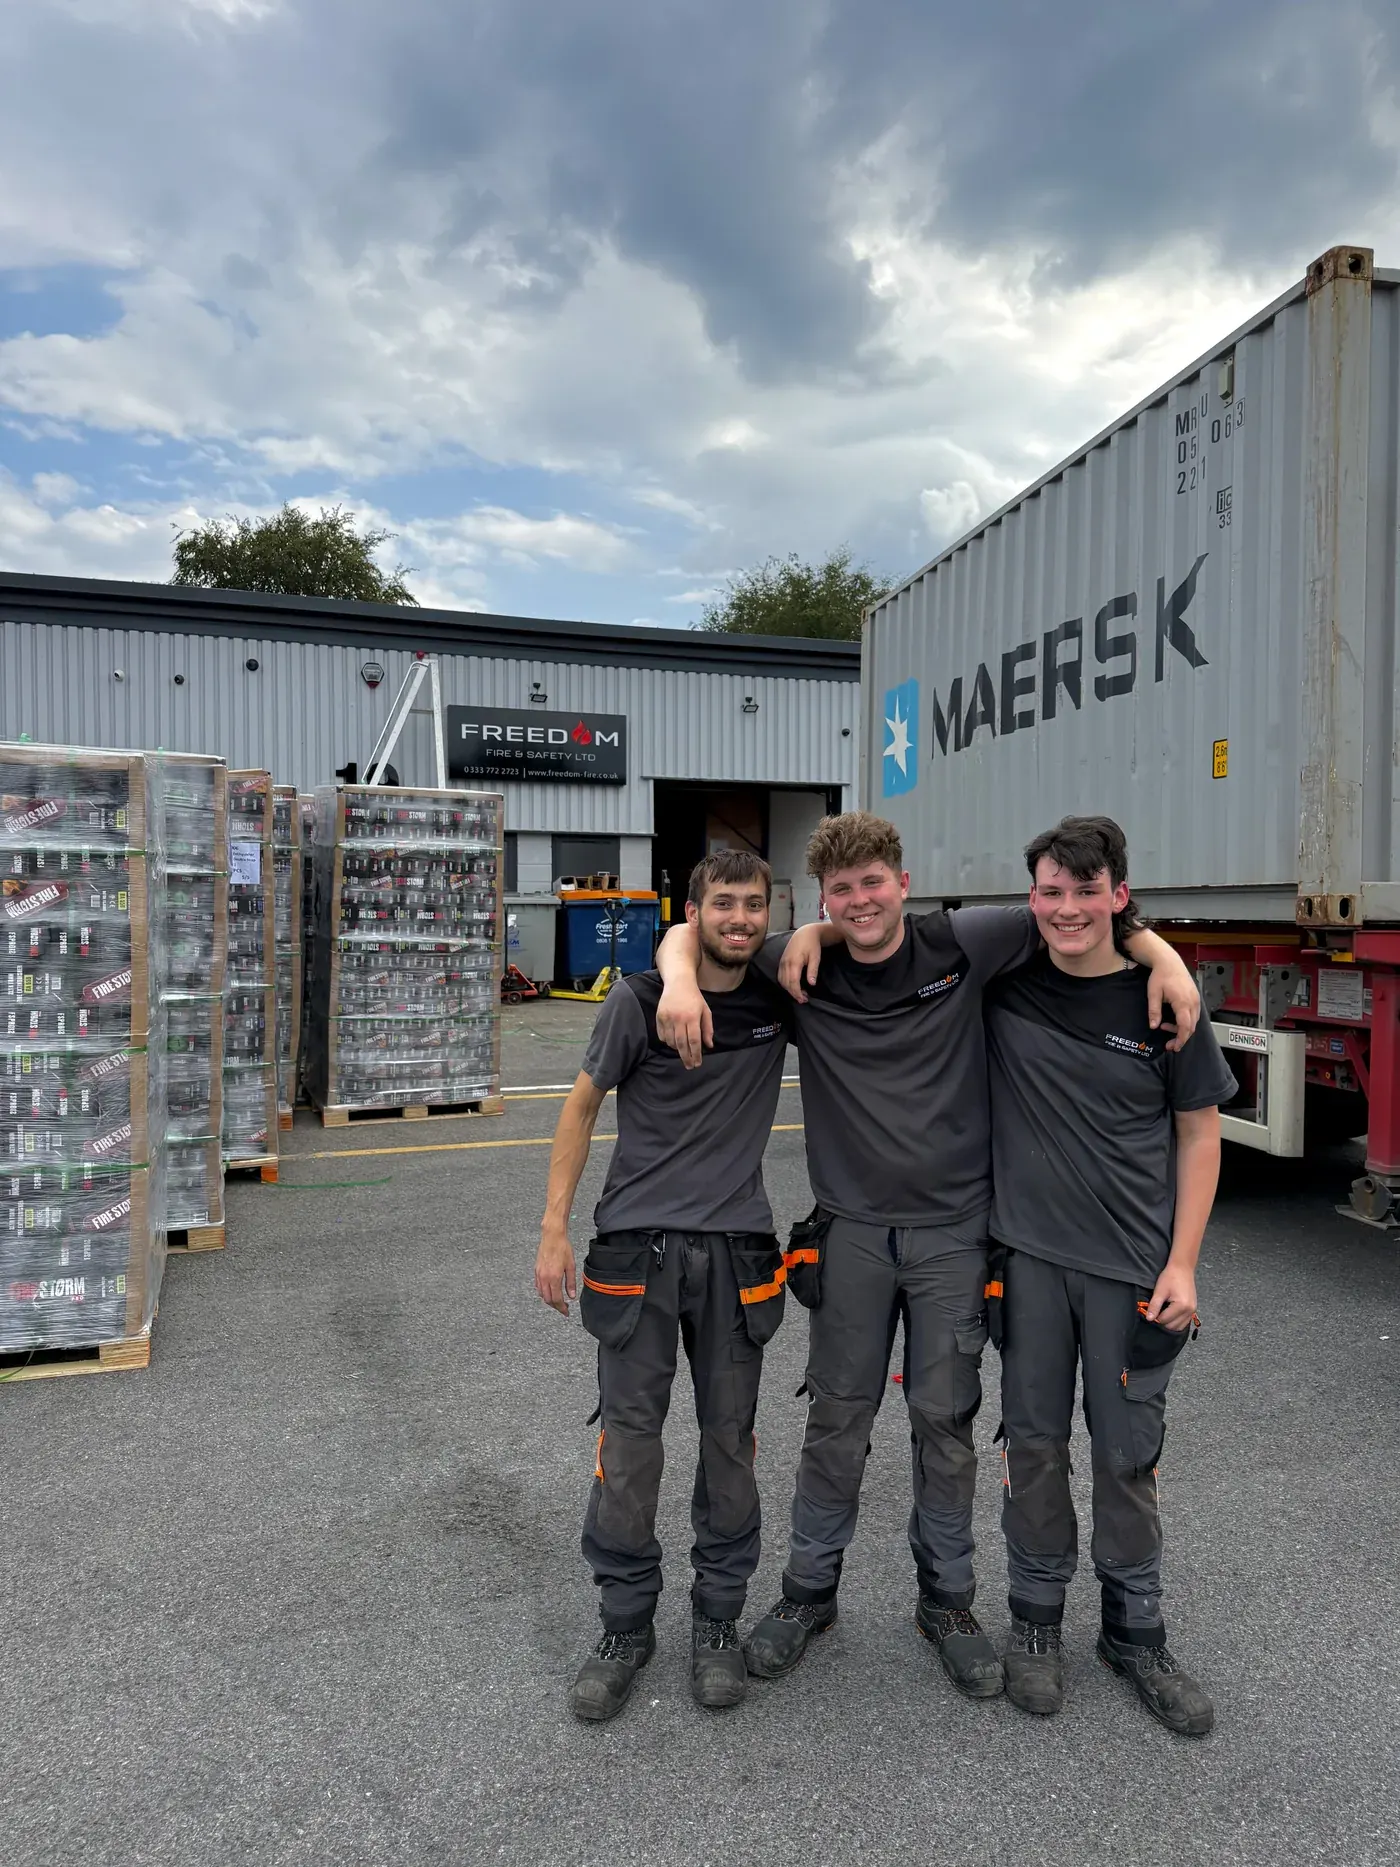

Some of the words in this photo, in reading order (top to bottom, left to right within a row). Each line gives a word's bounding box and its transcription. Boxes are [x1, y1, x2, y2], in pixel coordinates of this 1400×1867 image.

[931, 553, 1209, 760] MAERSK
[486, 749, 512, 758] FIRE
[515, 750, 523, 758] &
[526, 751, 572, 761] SAFETY
[575, 753, 596, 762] LTD
[486, 767, 500, 775] 772
[501, 768, 520, 776] 2723
[527, 769, 619, 780] www.freedom-fire.co.uk
[6, 885, 60, 918] FIRESTORM
[1105, 1033, 1154, 1053] FREEDOM
[1229, 1033, 1267, 1048] DENNISON
